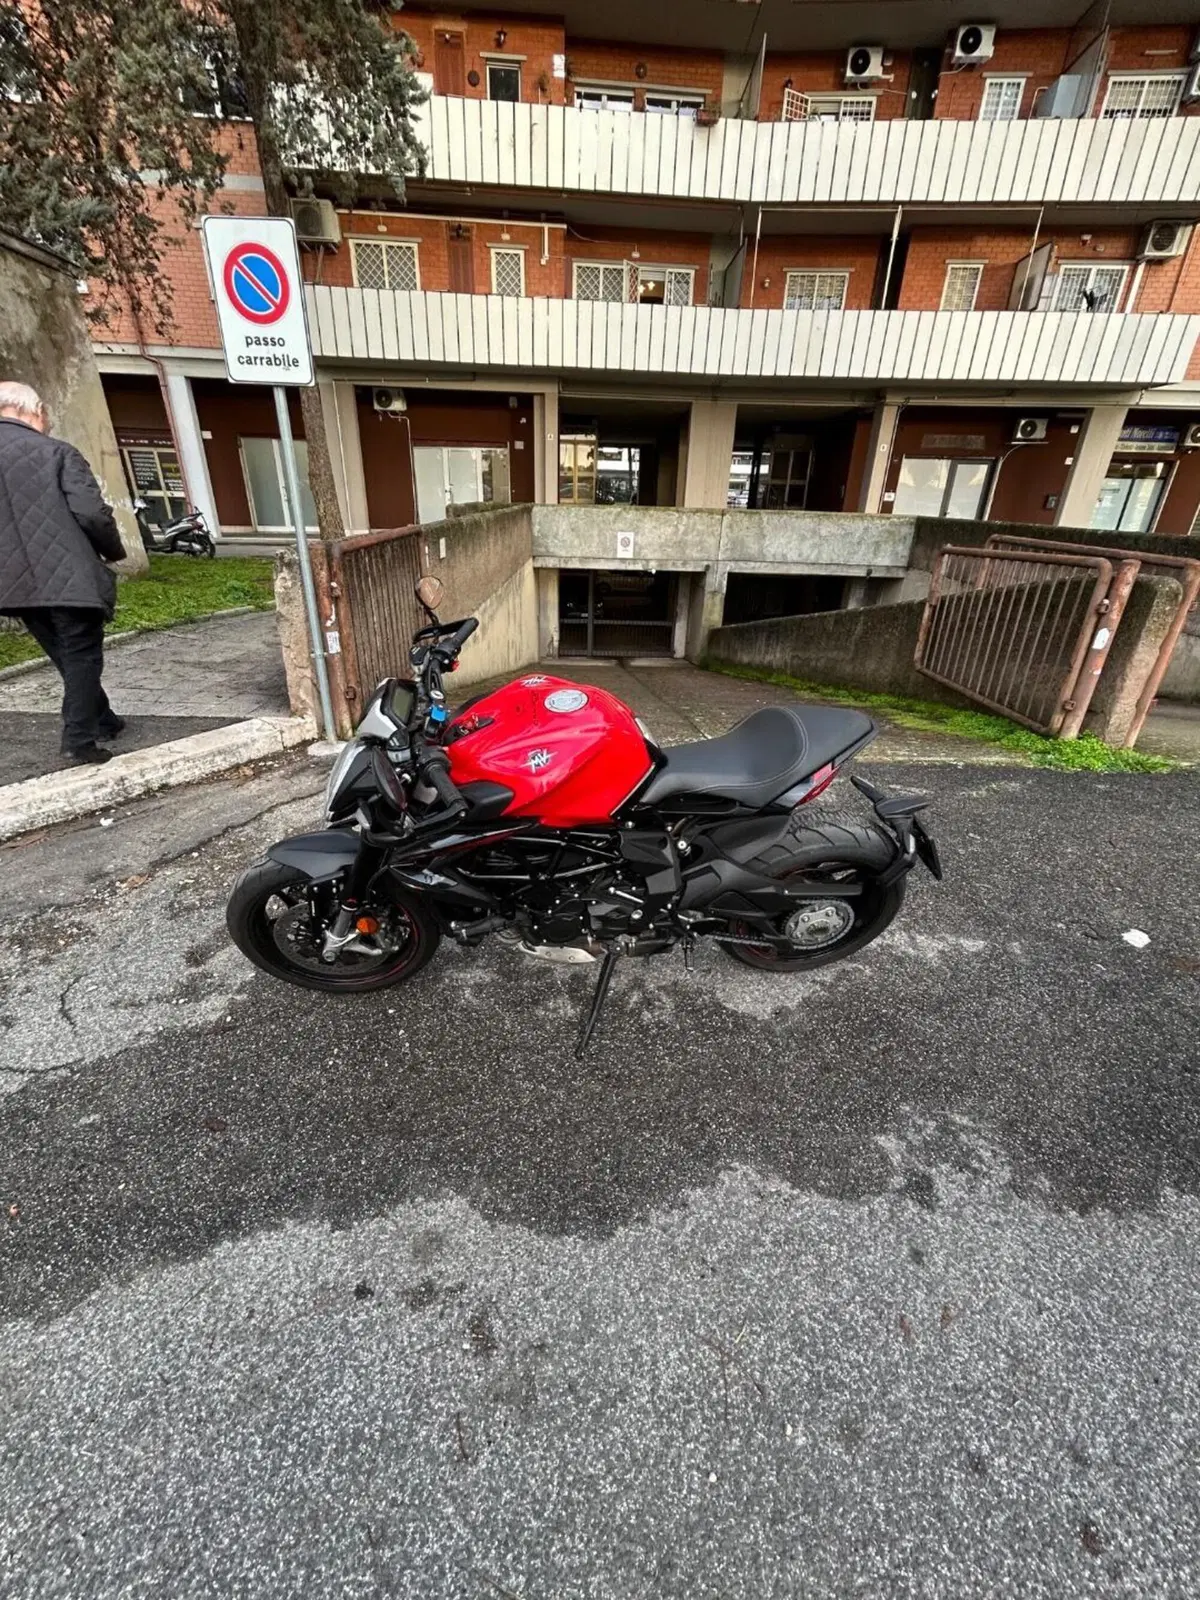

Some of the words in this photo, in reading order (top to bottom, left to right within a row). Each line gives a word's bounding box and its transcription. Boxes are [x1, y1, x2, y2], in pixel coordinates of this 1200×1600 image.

[244, 335, 286, 348] passo
[237, 353, 300, 368] carrabile
[521, 747, 557, 774] MV
